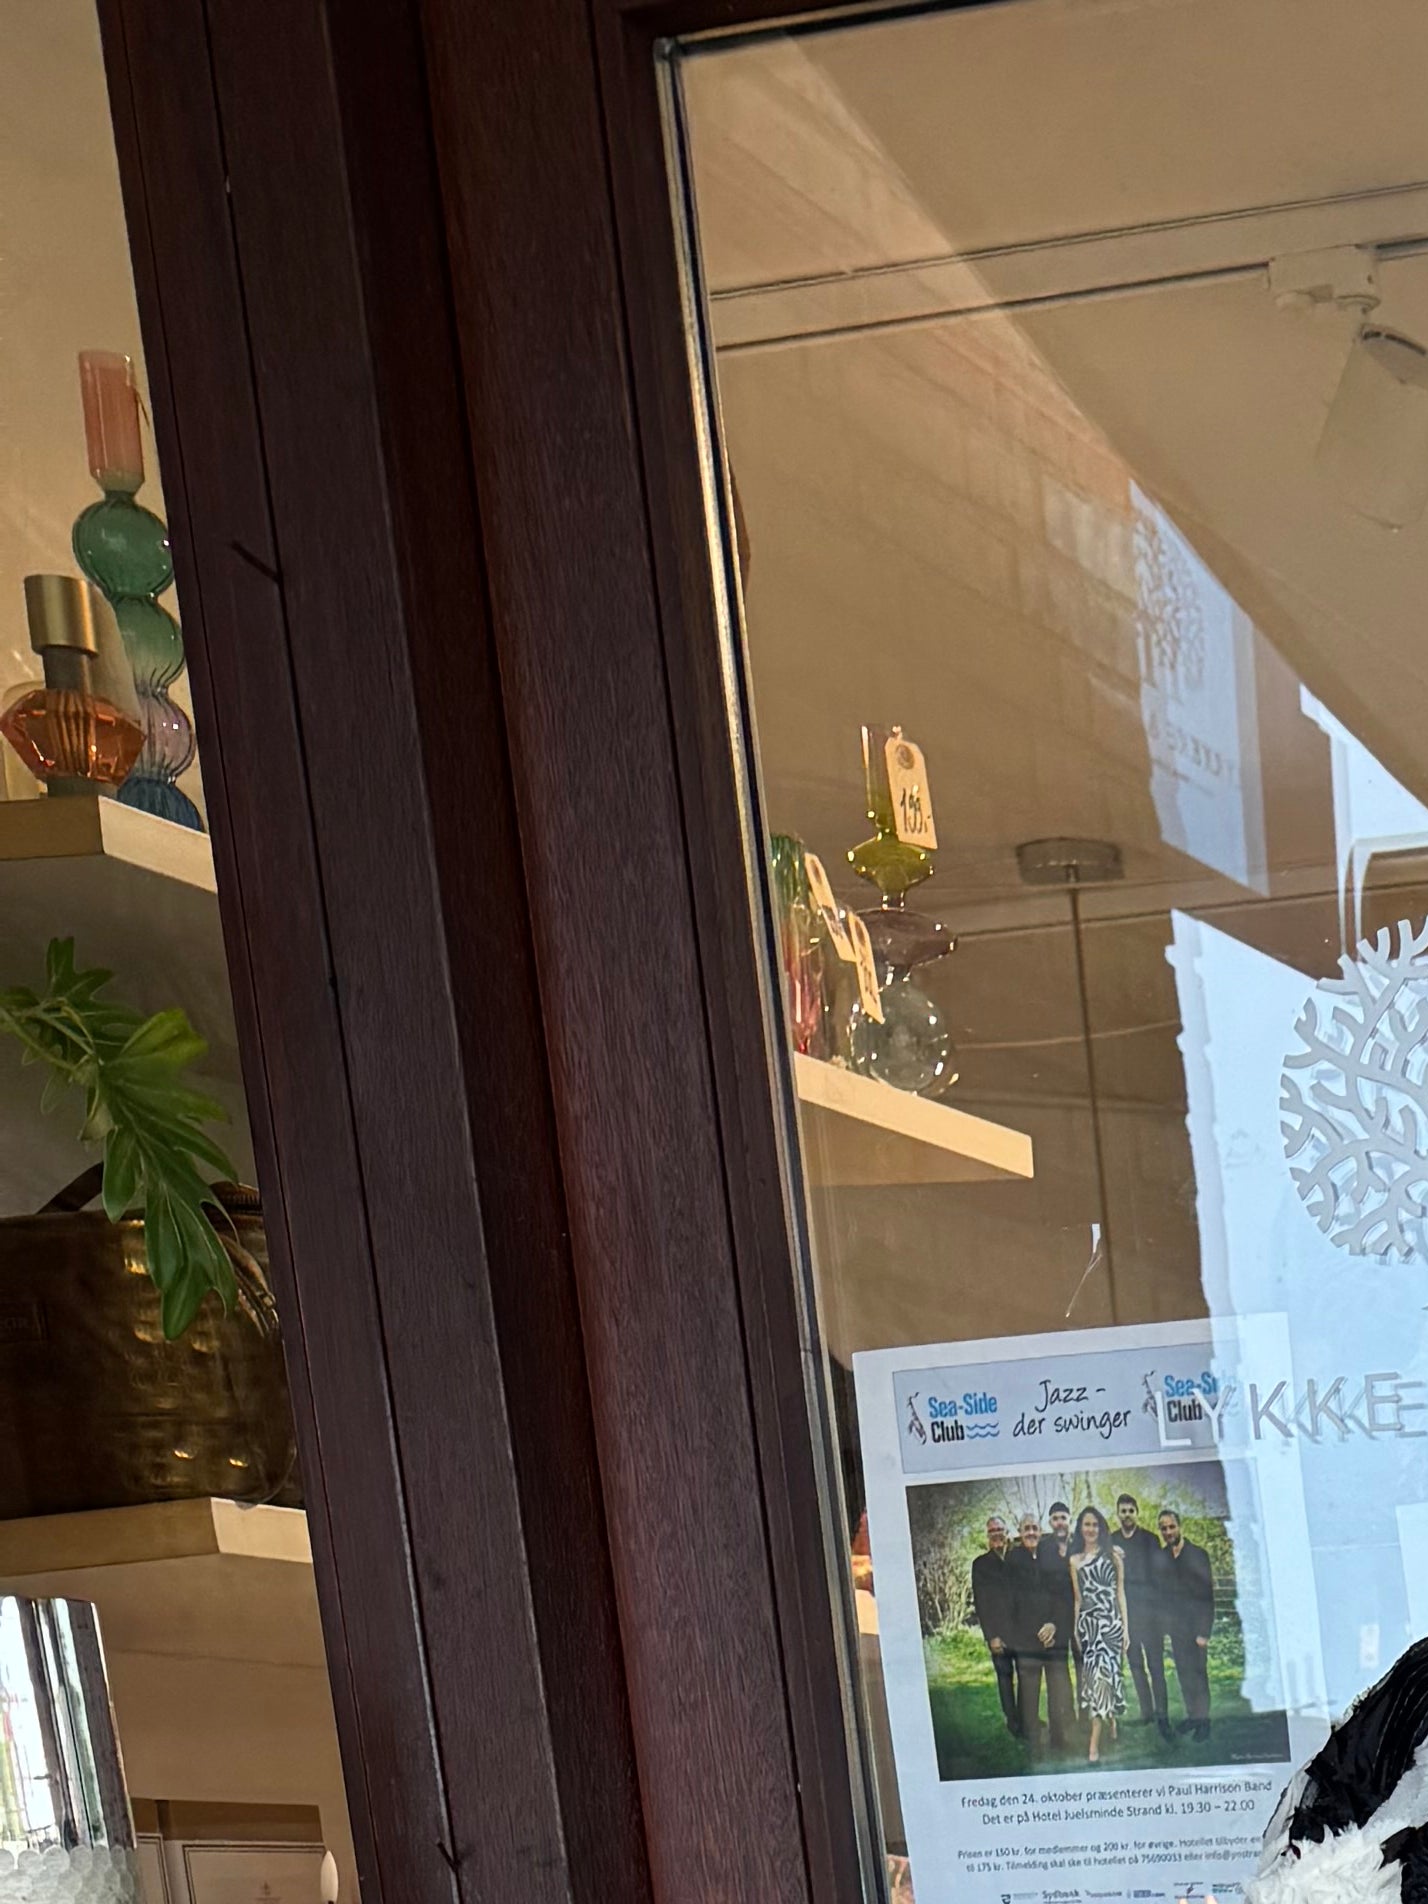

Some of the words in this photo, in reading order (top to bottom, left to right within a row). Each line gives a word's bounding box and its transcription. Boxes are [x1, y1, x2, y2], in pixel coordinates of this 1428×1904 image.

[928, 1392, 998, 1419] Sea-Side
[1035, 1379, 1088, 1413] Jazz
[1155, 1371, 1404, 1447] LYKKE
[931, 1420, 965, 1443] Club
[1013, 1412, 1045, 1437] der
[1054, 1409, 1131, 1439] swinger
[1040, 1789, 1082, 1805] oktober
[1168, 1783, 1192, 1797] Paul
[1194, 1781, 1241, 1796] Harrison
[1244, 1779, 1273, 1793] Band
[982, 1812, 1000, 1826] Det
[1003, 1814, 1014, 1824] er
[1032, 1808, 1062, 1823] Hotel
[1064, 1805, 1124, 1821] Juelsminde
[1126, 1803, 1162, 1818] Strand
